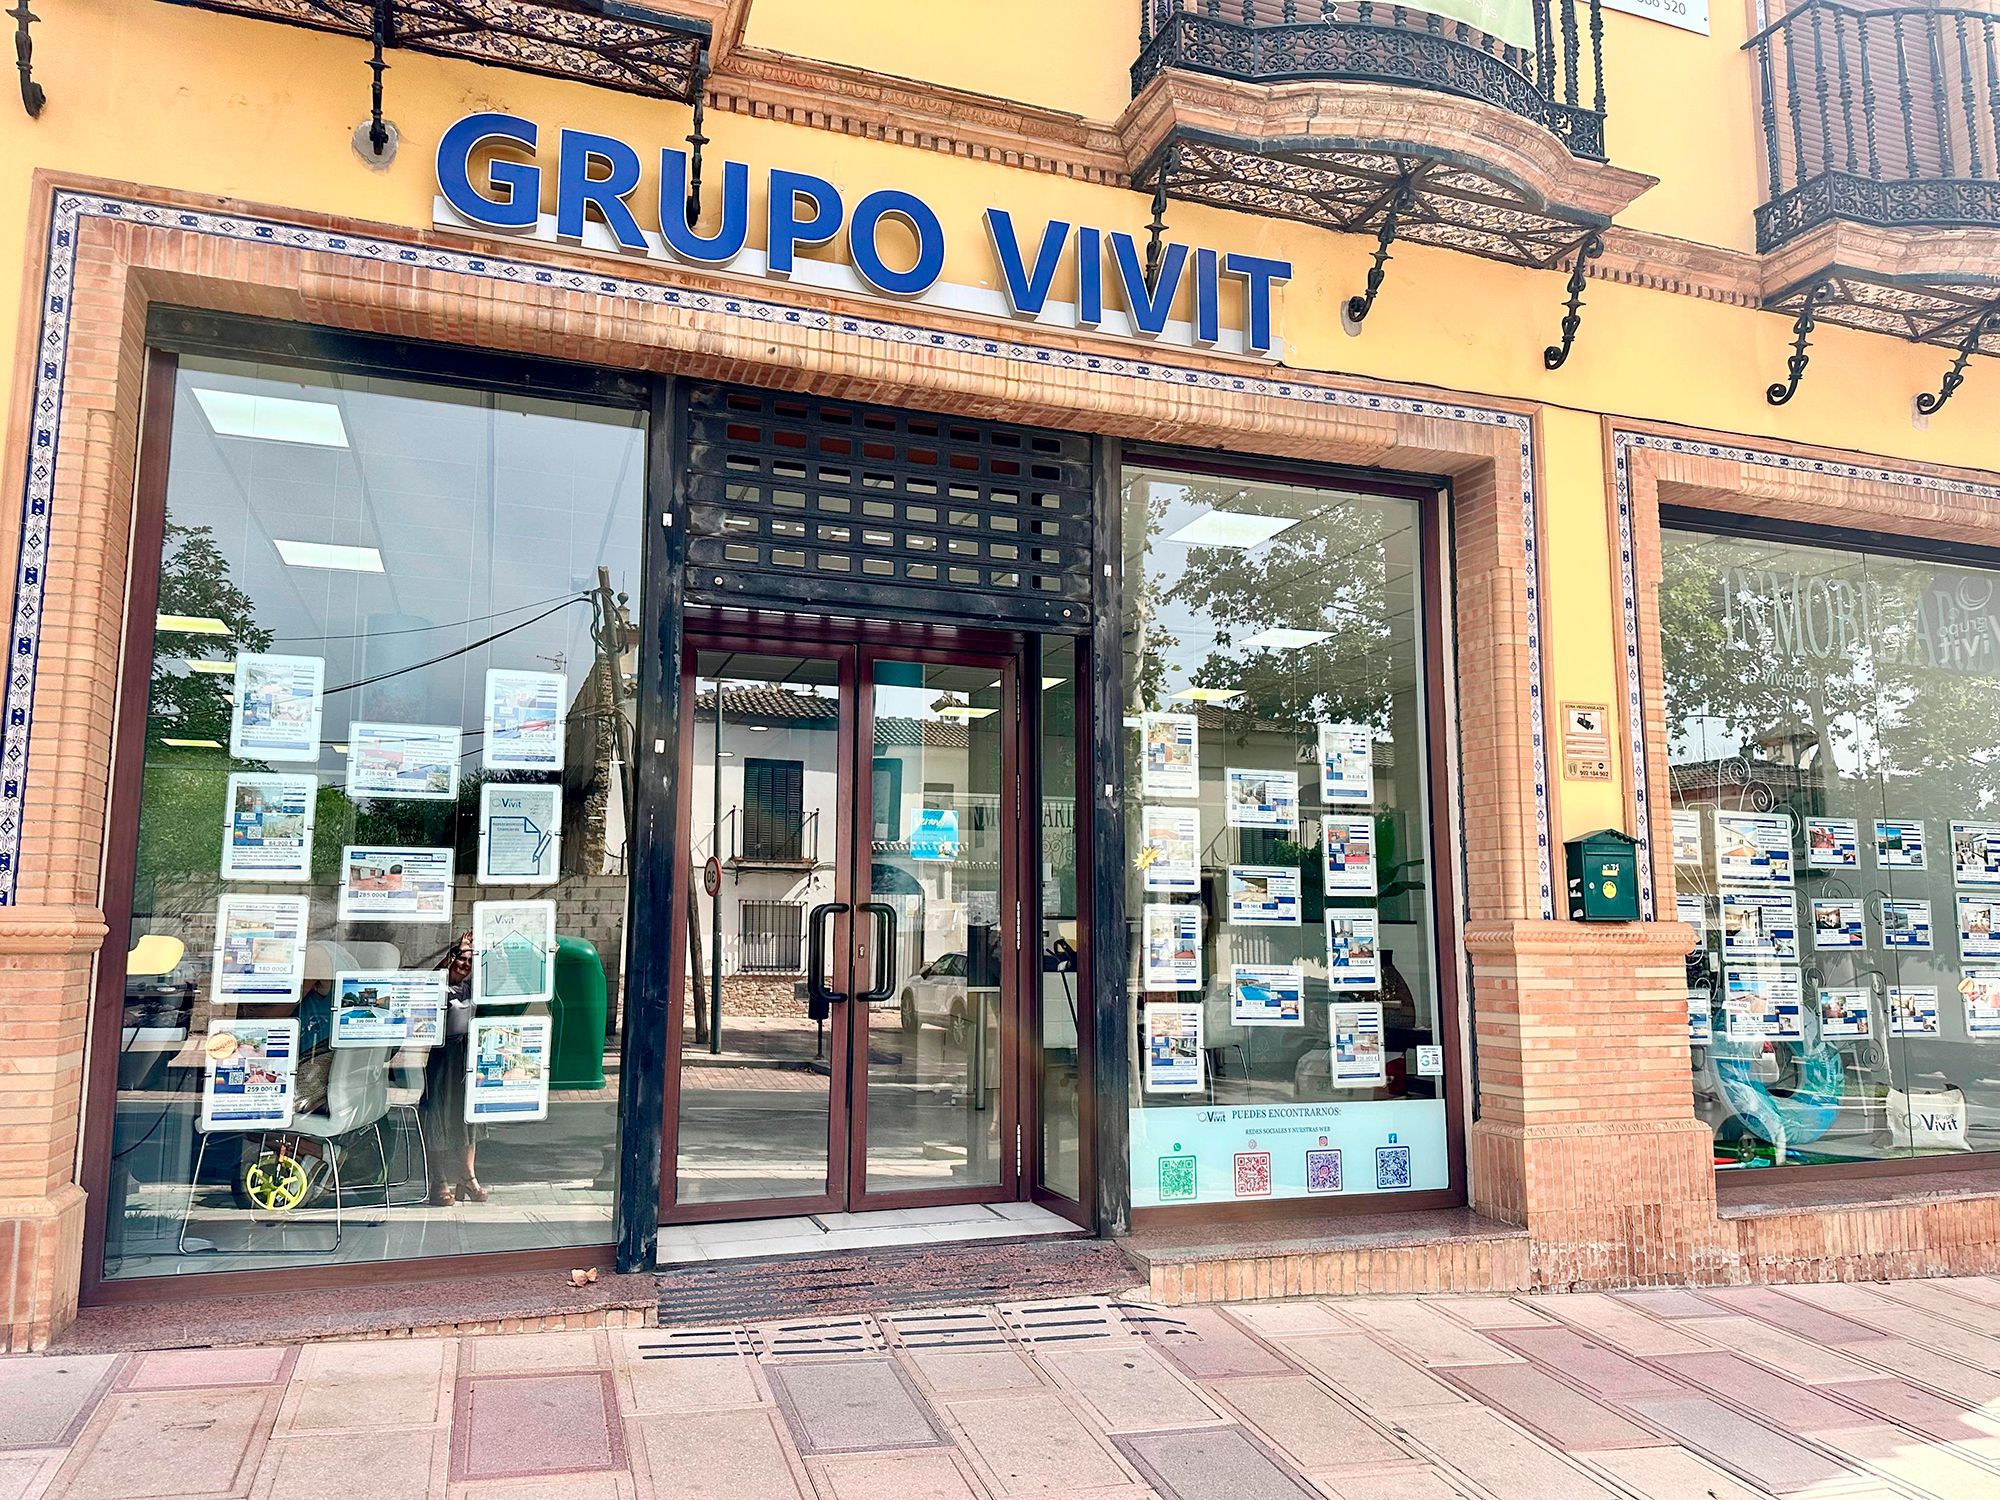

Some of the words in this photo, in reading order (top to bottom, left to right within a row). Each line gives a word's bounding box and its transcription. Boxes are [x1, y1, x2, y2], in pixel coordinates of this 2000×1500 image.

[435, 111, 945, 299] GRUPO
[984, 207, 1294, 355] VIVIT
[1207, 1111, 1226, 1123] Vivit
[1232, 1108, 1267, 1120] PUEDES
[1268, 1106, 1342, 1118] ENCONTRARNOS:
[1920, 1113, 1958, 1132] Vivit
[1263, 1127, 1288, 1135] SOCIALES
